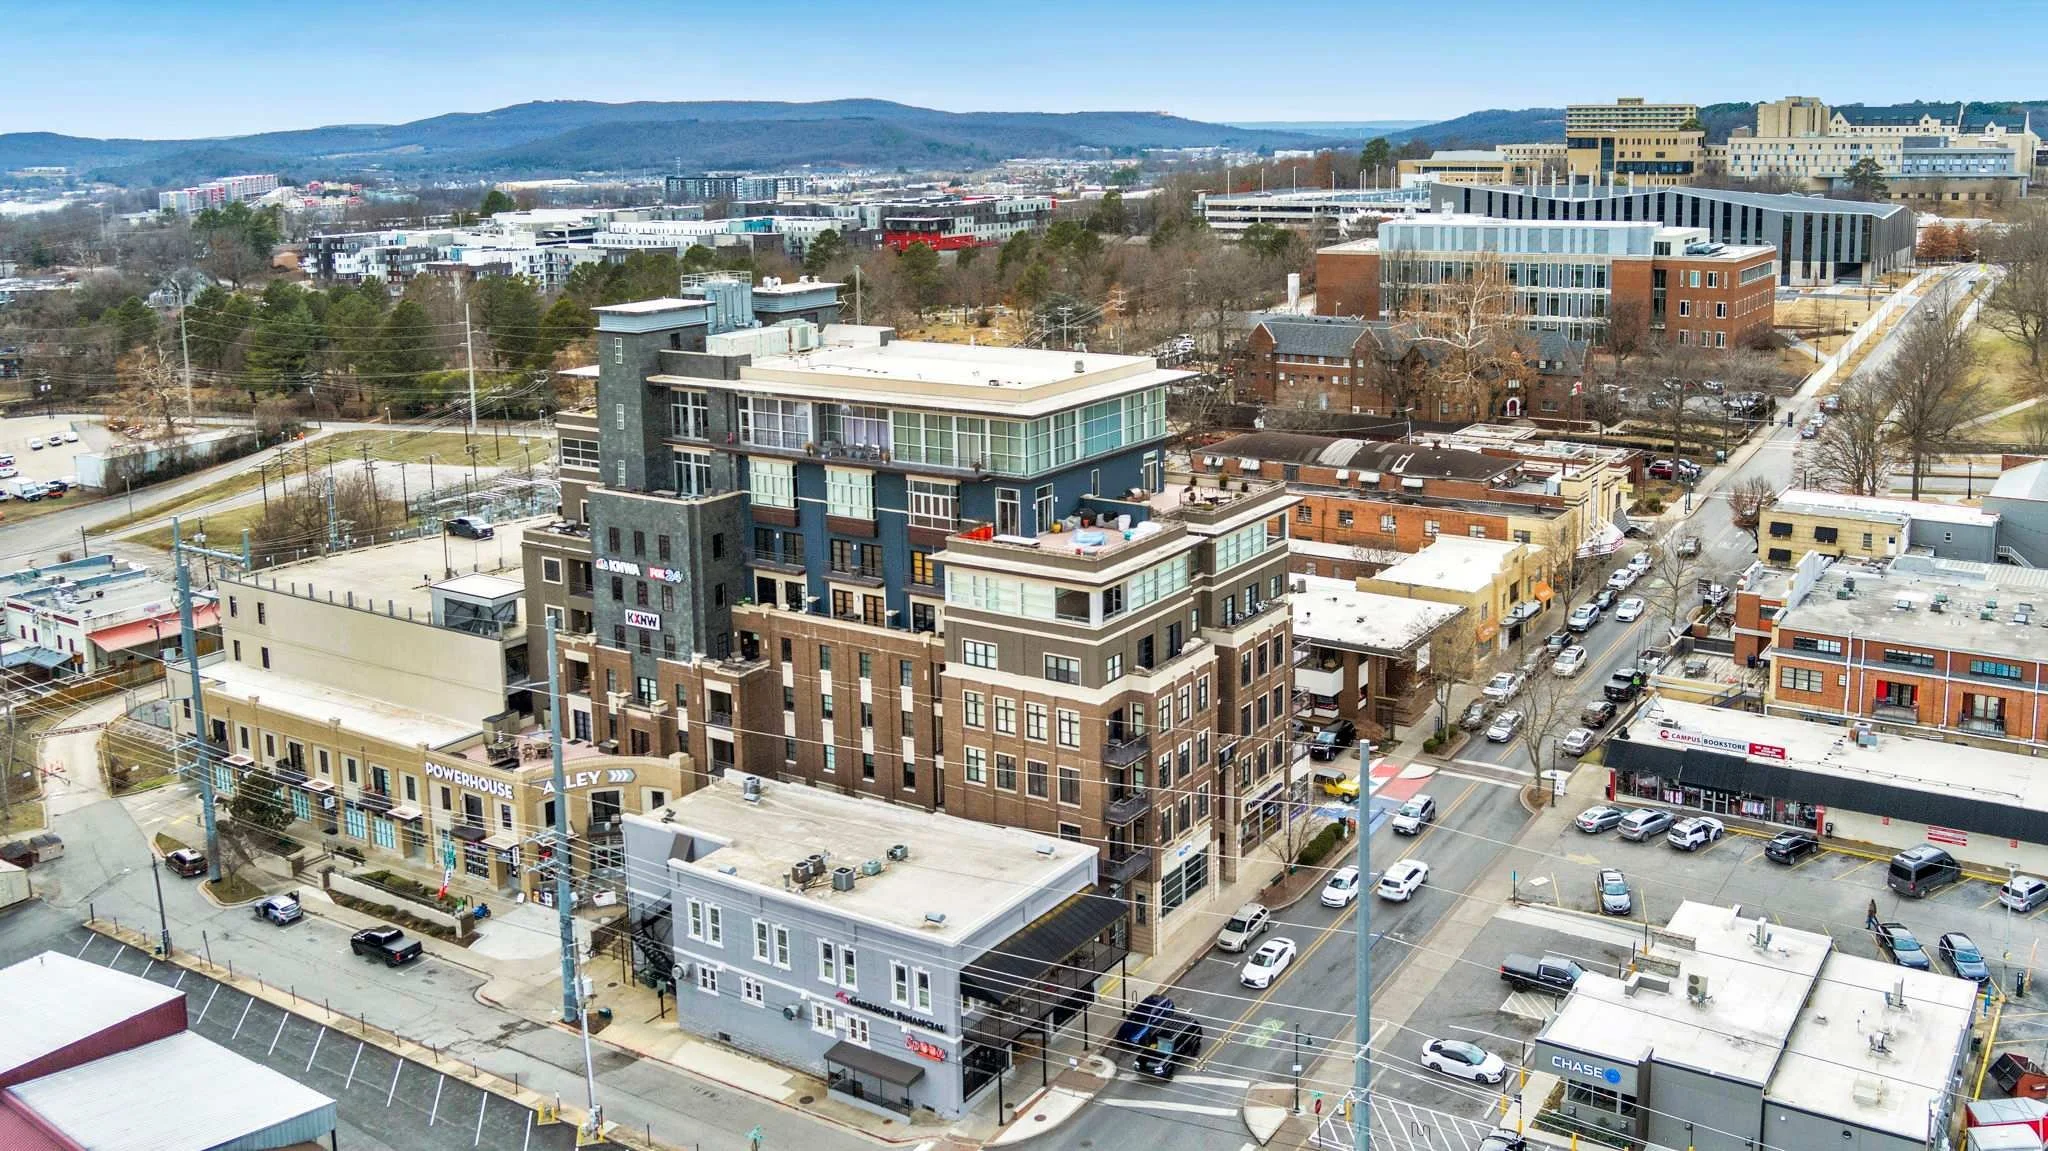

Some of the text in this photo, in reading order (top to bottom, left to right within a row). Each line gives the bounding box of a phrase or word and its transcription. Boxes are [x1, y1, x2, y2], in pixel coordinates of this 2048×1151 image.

[609, 559, 641, 577] KNWA
[627, 611, 657, 628] KXNW
[1671, 732, 1746, 751] CAMPUS BOOKSTORE
[425, 761, 602, 800] POWERHOUSE ALEY
[896, 1011, 946, 1033] FINANCIAL
[1551, 1055, 1603, 1079] CHASE
